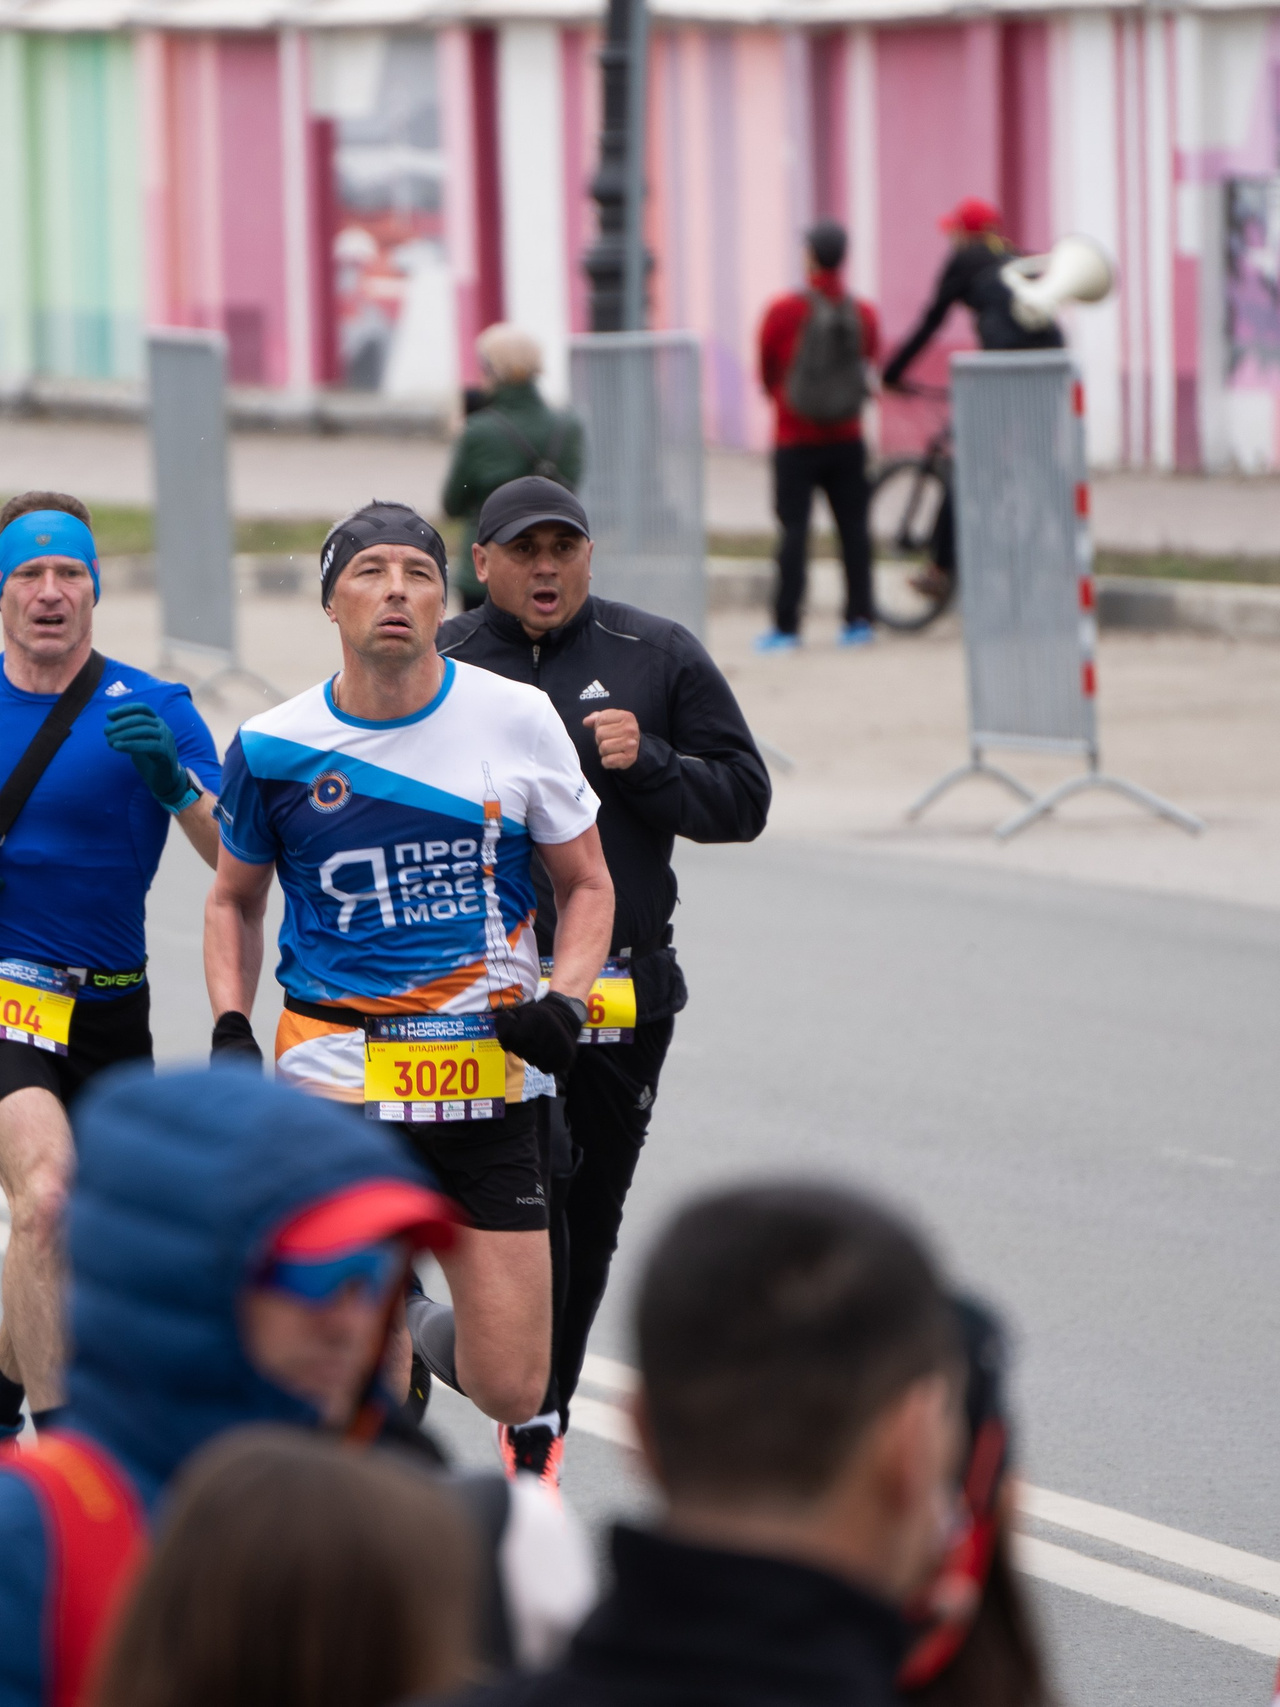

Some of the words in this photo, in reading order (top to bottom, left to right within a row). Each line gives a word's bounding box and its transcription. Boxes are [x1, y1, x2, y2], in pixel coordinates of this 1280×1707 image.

[579, 690, 610, 700] adidas
[394, 838, 478, 864] ПРО
[398, 860, 478, 885] СТО
[319, 846, 397, 933] Я
[399, 875, 477, 902] КОС
[402, 895, 480, 926] МОС
[407, 1028, 465, 1037] КОСМОС
[417, 1021, 465, 1029] ПРОСТО
[408, 1044, 459, 1053] ВЛАДИМИР
[393, 1058, 480, 1097] 3020
